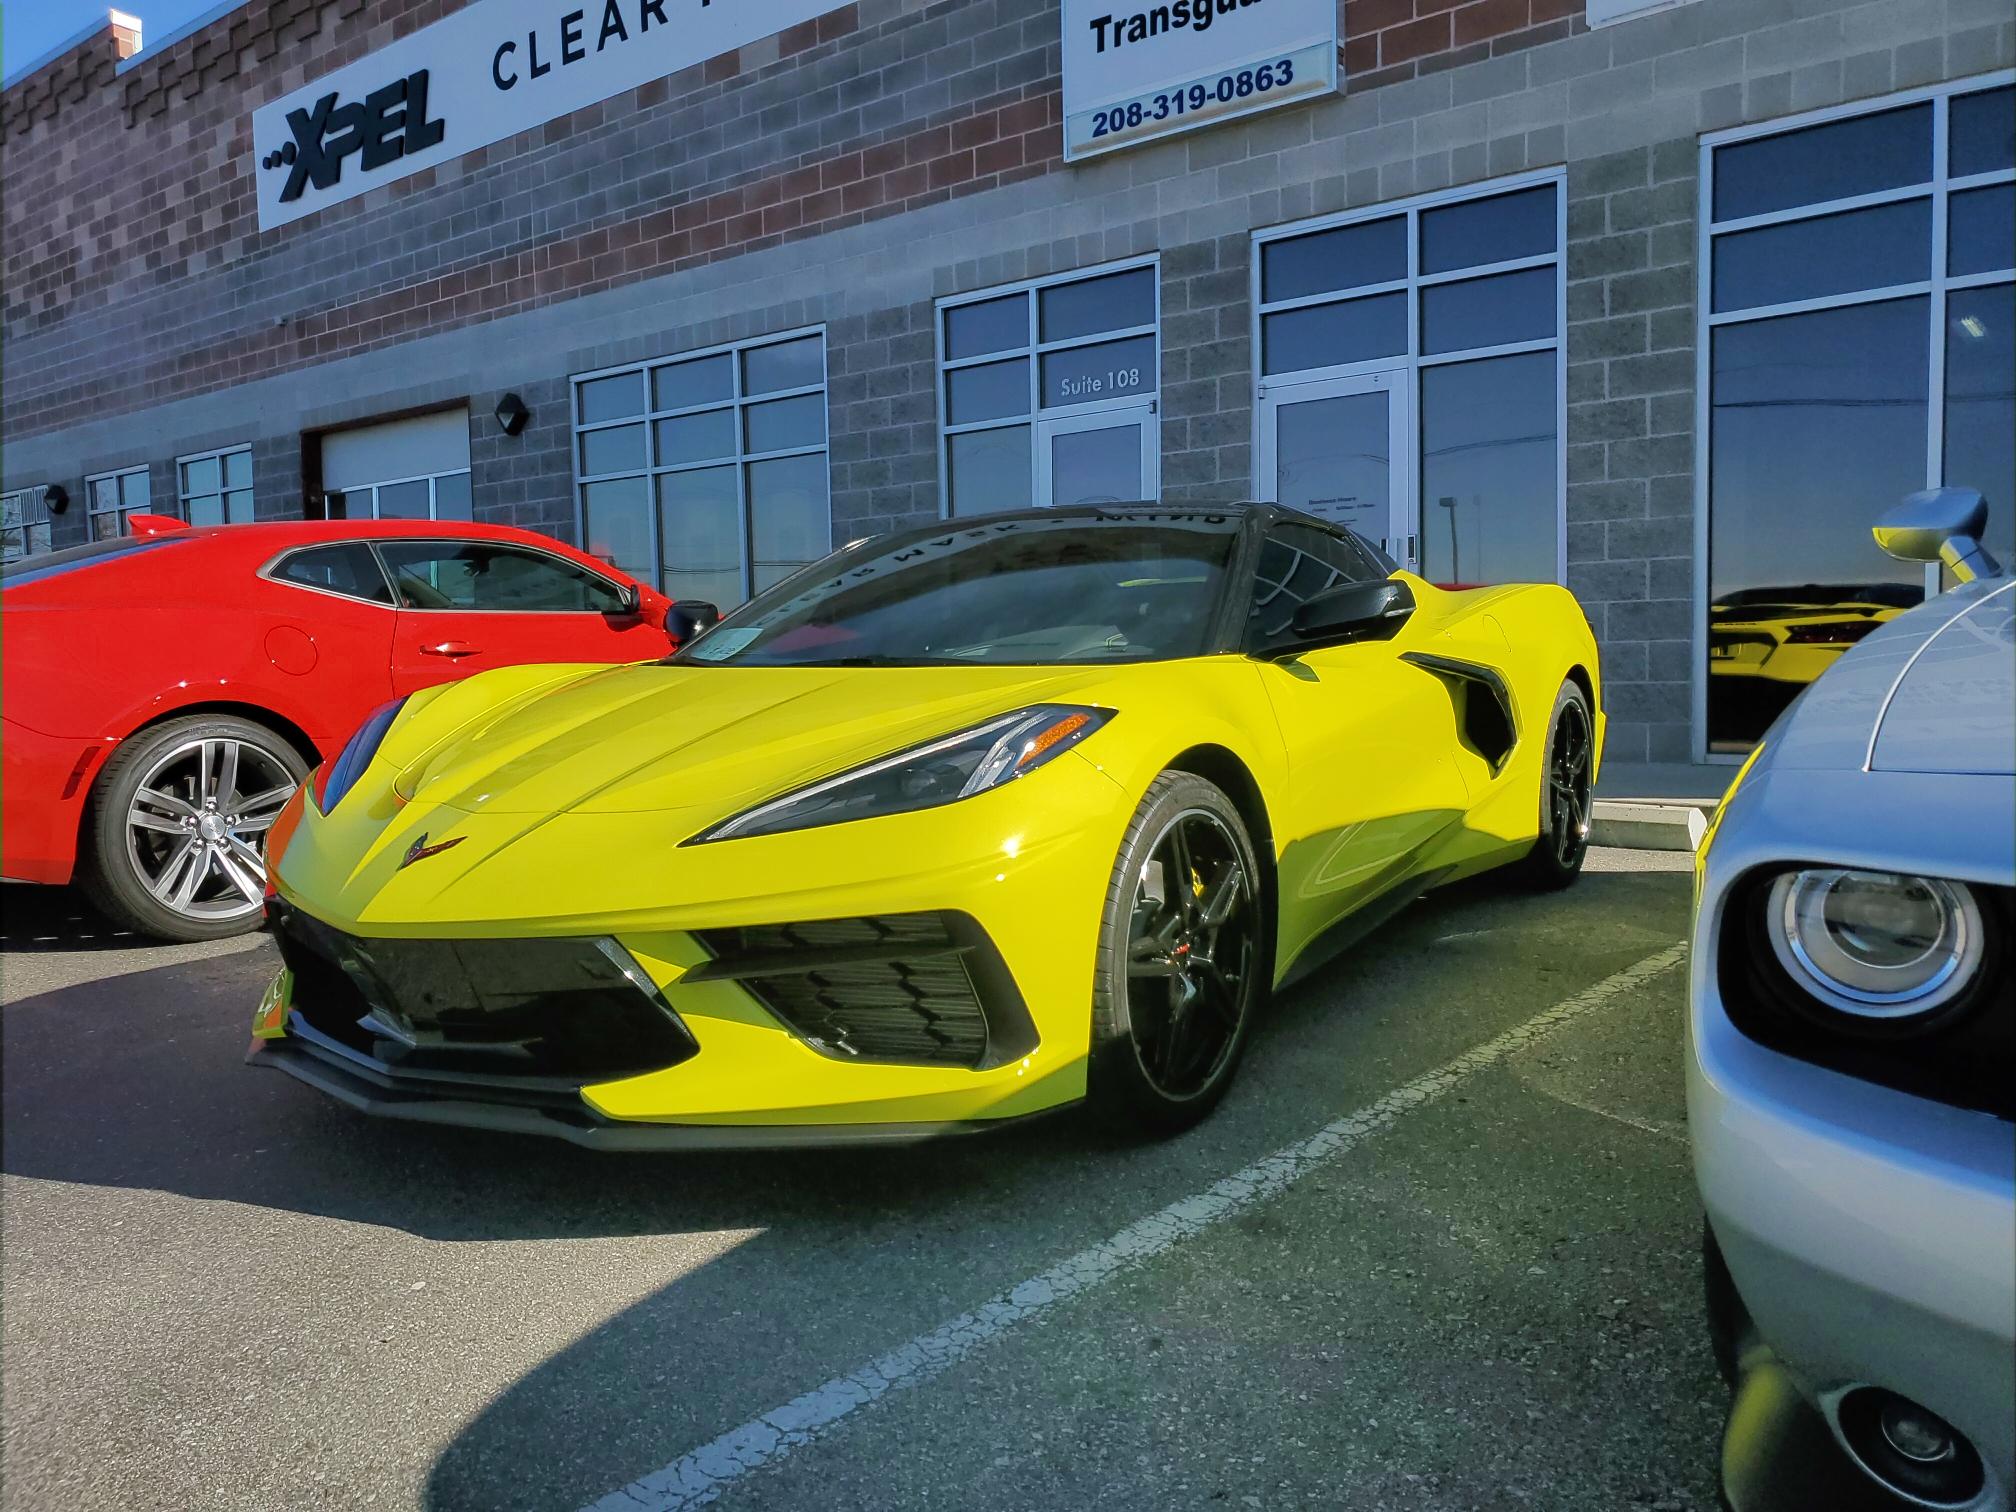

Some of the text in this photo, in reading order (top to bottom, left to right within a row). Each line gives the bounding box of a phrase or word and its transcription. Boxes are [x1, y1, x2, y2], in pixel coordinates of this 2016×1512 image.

[1090, 0, 1263, 53] Transgu
[279, 0, 669, 203] XPEL CLEAR
[1092, 59, 1294, 138] 208-319-0863
[1061, 368, 1140, 396] Suite 108
